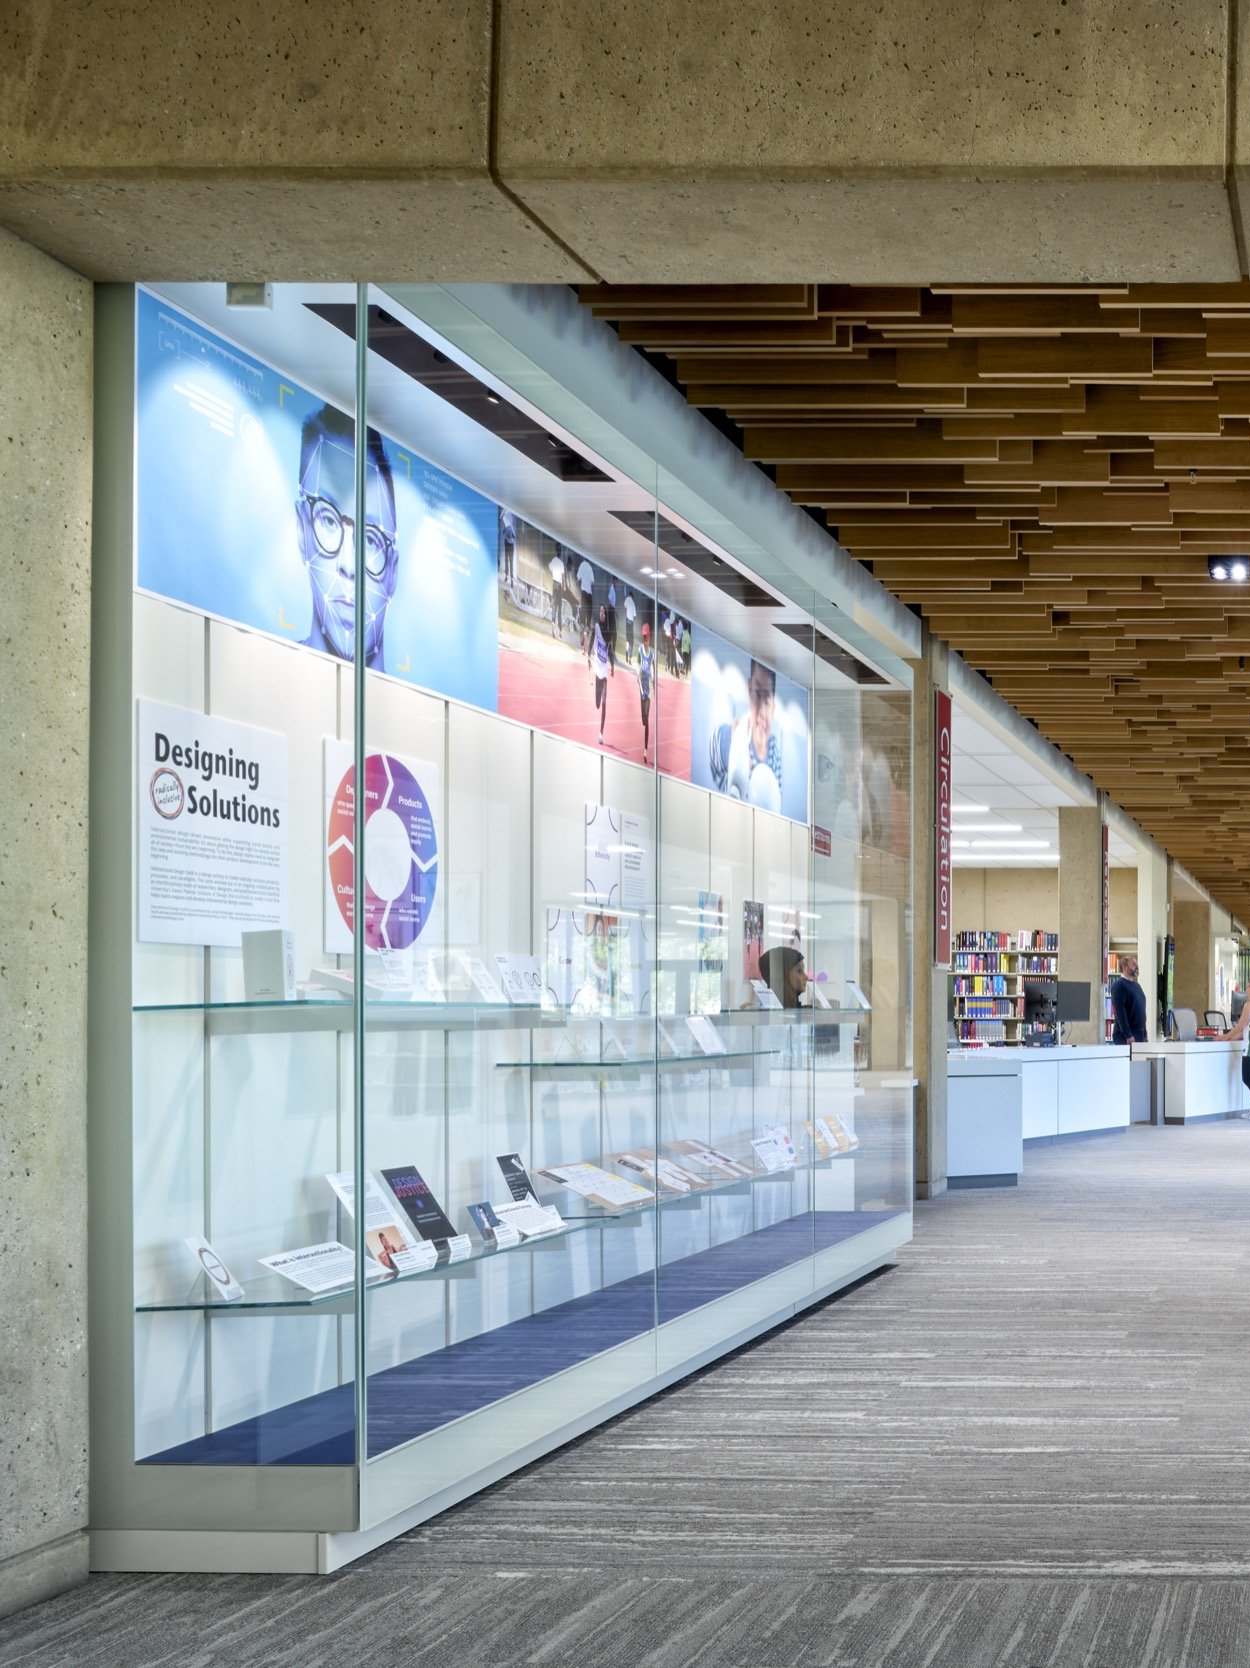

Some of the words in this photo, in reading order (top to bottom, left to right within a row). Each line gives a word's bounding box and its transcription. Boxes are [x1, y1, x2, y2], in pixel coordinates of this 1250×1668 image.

[154, 732, 260, 791] Designing
[187, 785, 281, 828] Solutions
[398, 795, 423, 809] Products
[941, 727, 950, 931] Circulation
[410, 893, 427, 904] Users
